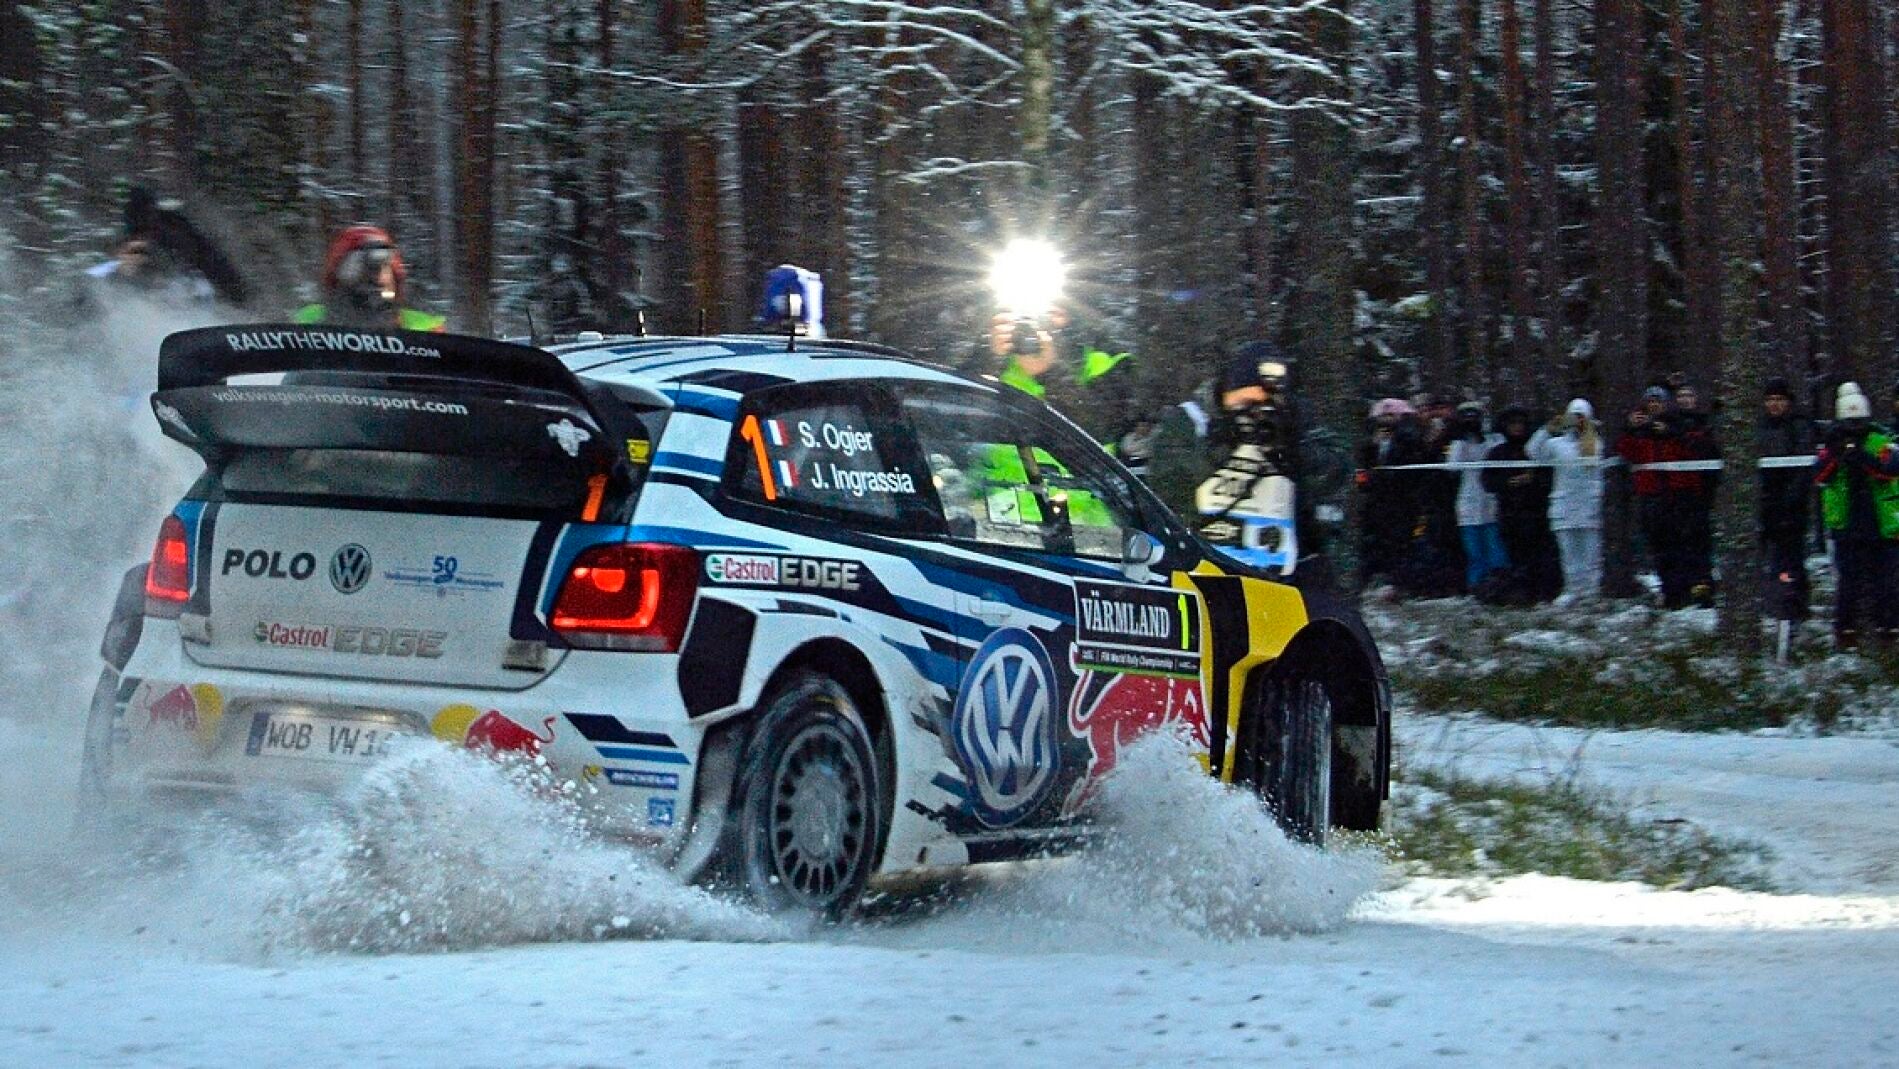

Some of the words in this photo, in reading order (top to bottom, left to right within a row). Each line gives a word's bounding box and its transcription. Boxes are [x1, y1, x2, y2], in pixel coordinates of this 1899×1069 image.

[798, 421, 821, 449] S.
[822, 422, 873, 457] Ogier
[740, 414, 777, 501] 1
[811, 462, 829, 489] J.
[831, 463, 916, 497] Ingrassia
[222, 548, 317, 581] POLO
[432, 555, 457, 575] 50
[725, 556, 776, 583] Castrol
[780, 557, 862, 592] EDGE
[1081, 589, 1171, 638] VÄRMLAND
[1177, 594, 1189, 650] 1
[269, 622, 329, 649] Castrol
[333, 626, 448, 660] EDGE
[267, 720, 313, 750] WOB
